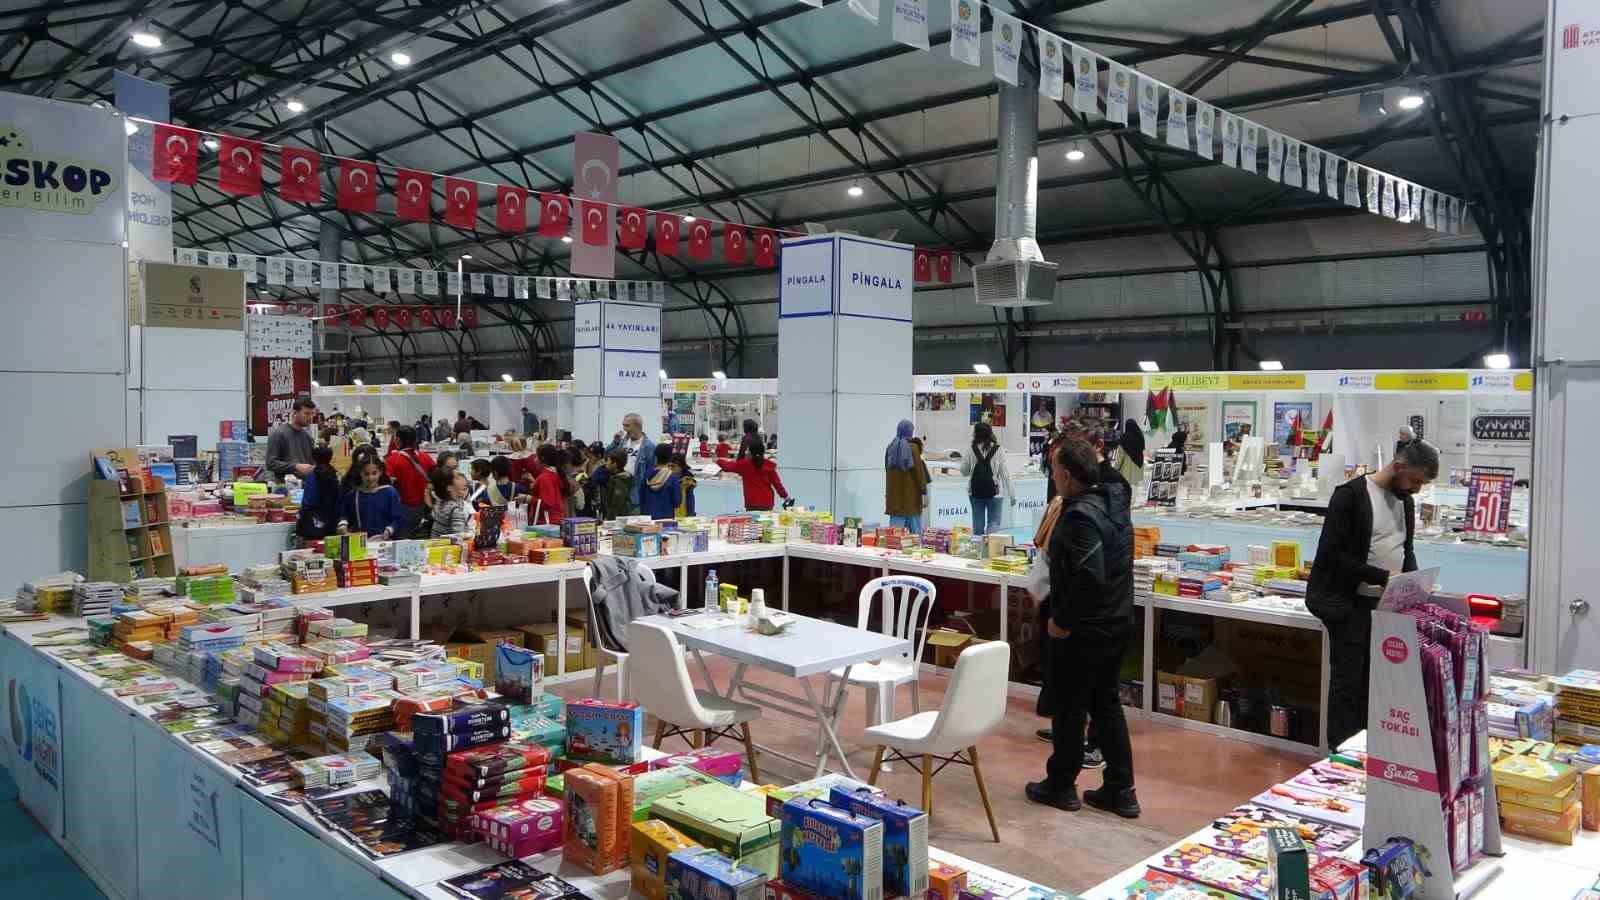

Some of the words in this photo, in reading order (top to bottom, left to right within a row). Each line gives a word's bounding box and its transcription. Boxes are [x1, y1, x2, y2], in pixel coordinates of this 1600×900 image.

[0, 158, 111, 195] SKOP
[33, 191, 85, 209] Bilim
[787, 275, 826, 285] PİNGALA
[852, 272, 902, 290] PİNGALA
[618, 370, 648, 378] RAVZA
[1479, 480, 1502, 493] TANE
[1018, 499, 1044, 509] PİNGALA
[939, 507, 968, 517] PİNGALA
[1473, 492, 1501, 532] 50
[1380, 720, 1420, 737] TOKASI
